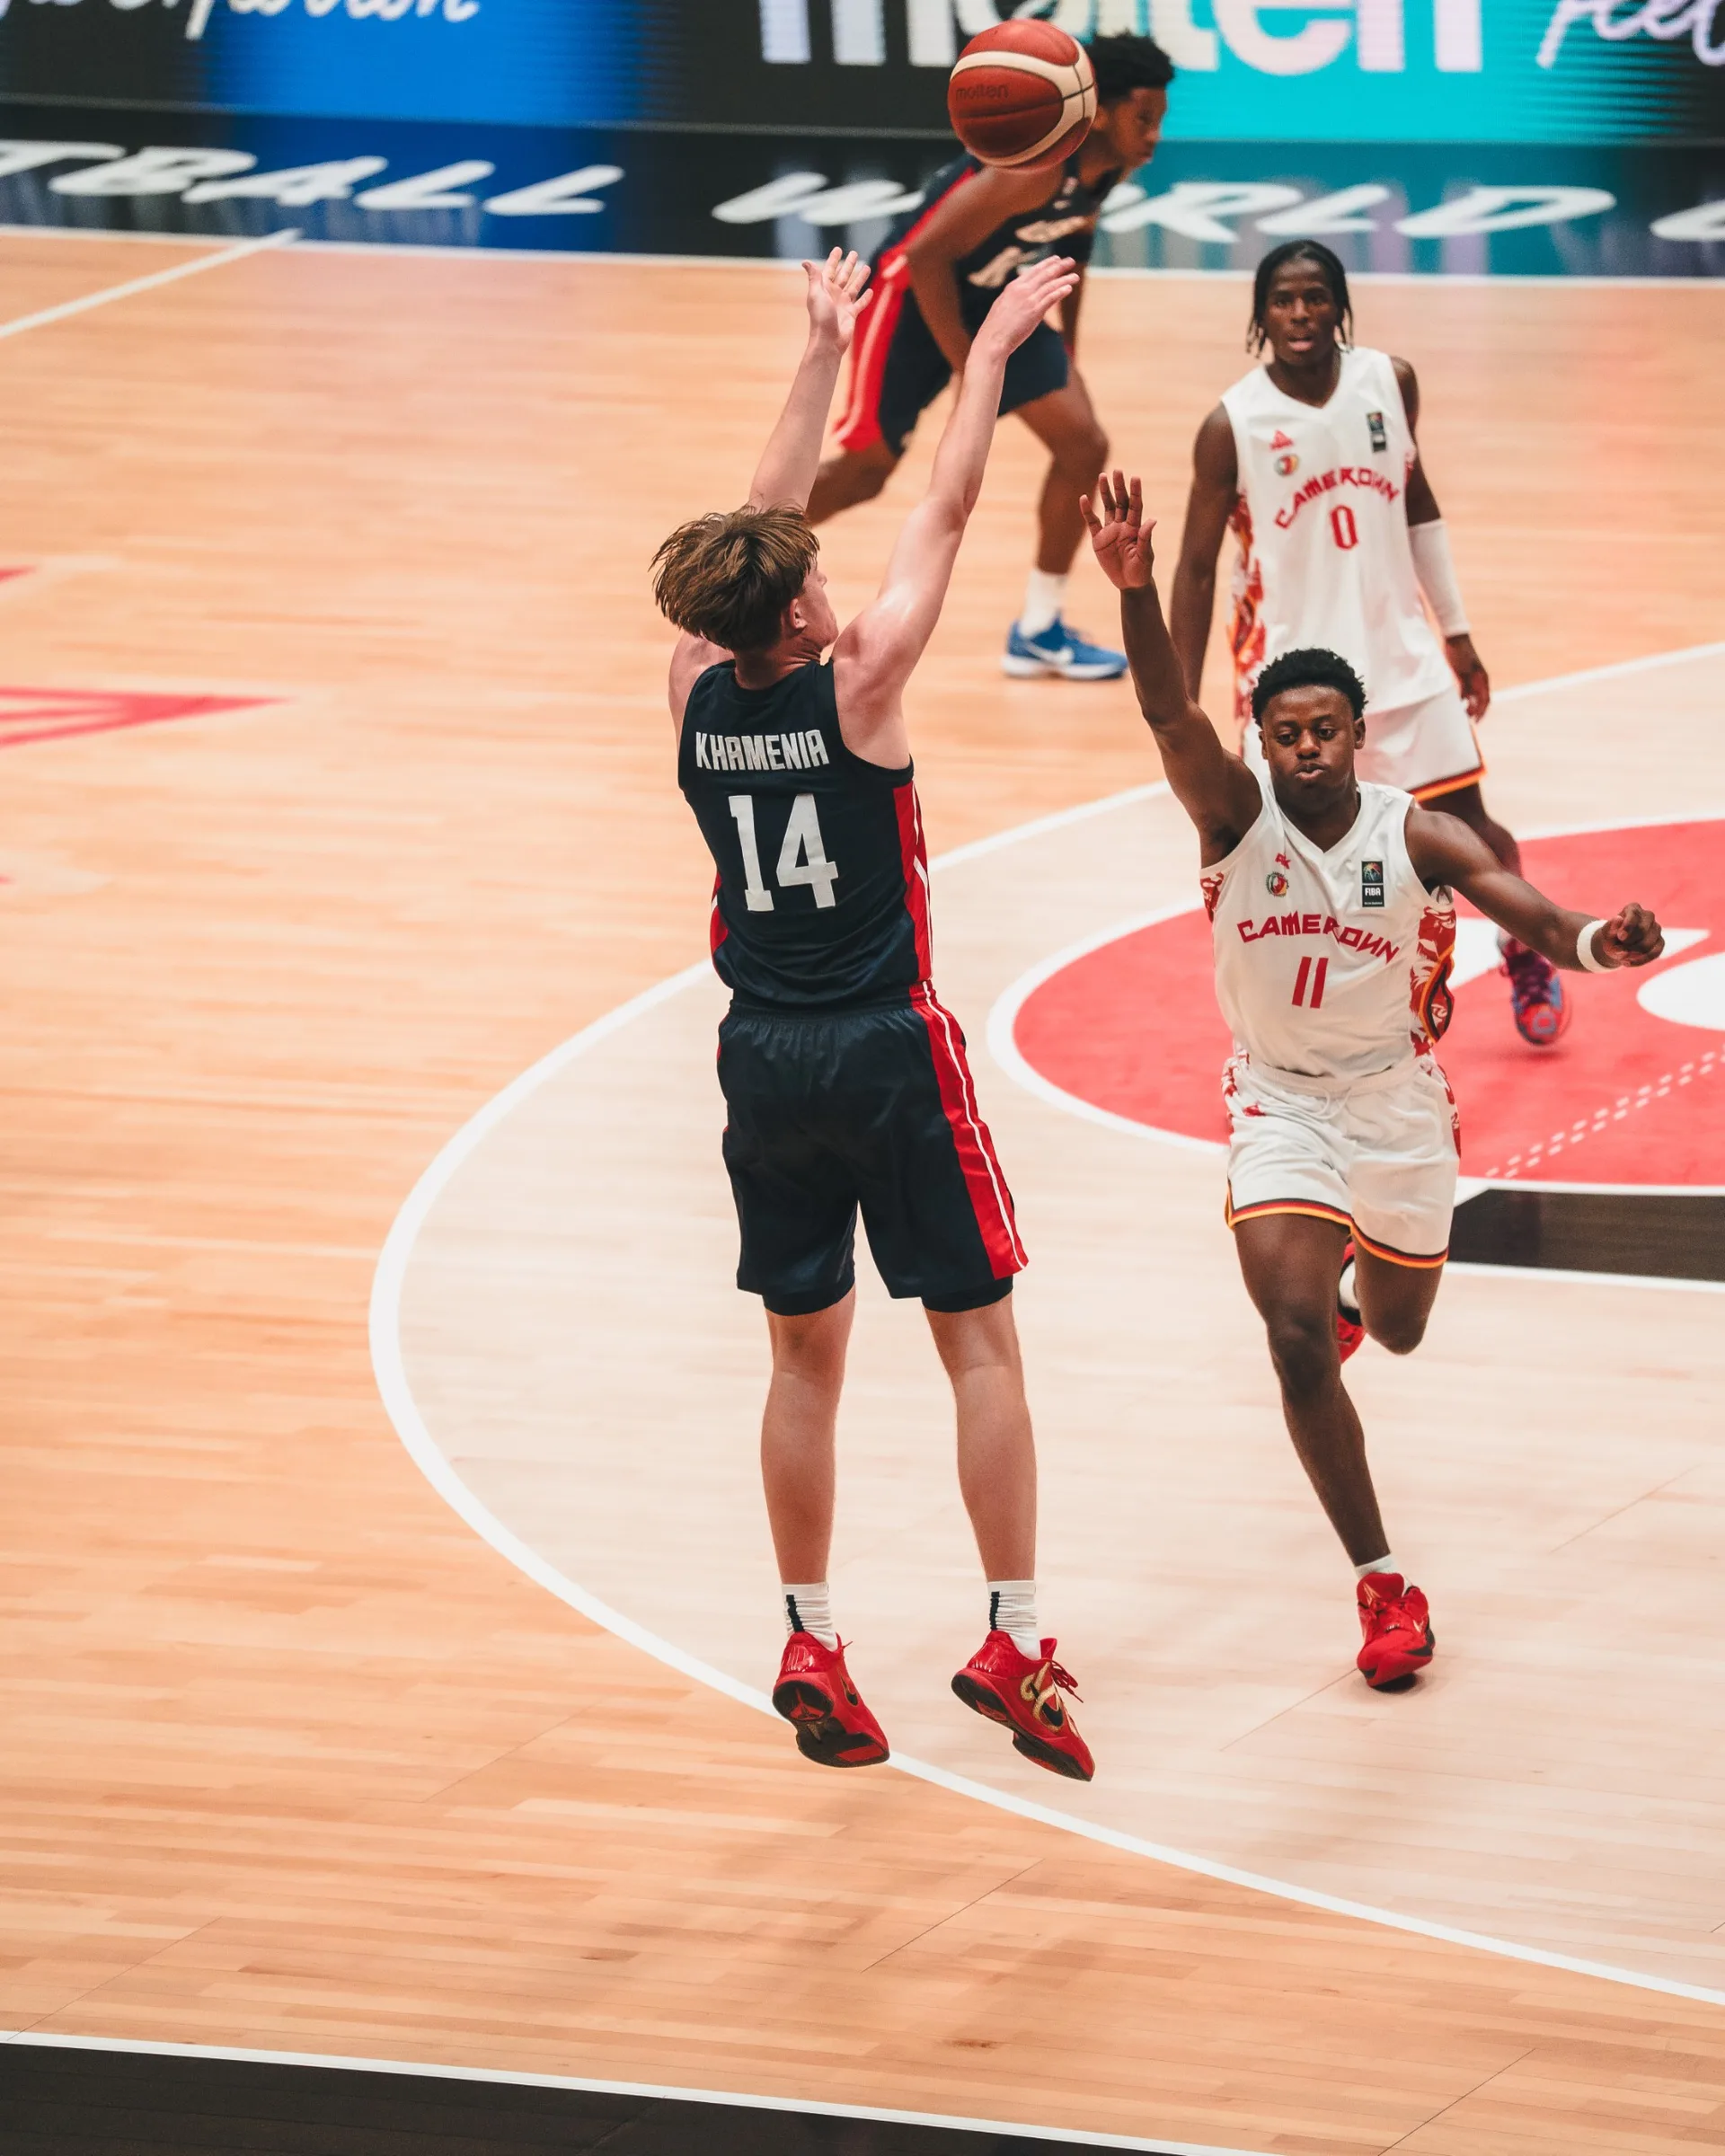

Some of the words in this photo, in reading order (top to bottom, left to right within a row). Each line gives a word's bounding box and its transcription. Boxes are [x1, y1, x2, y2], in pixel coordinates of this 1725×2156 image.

[1330, 504, 1359, 551] 0
[695, 729, 829, 771] KHAMENIA
[728, 793, 839, 912] 14
[1364, 887, 1382, 897] FIBA
[1291, 956, 1329, 1009] 11
